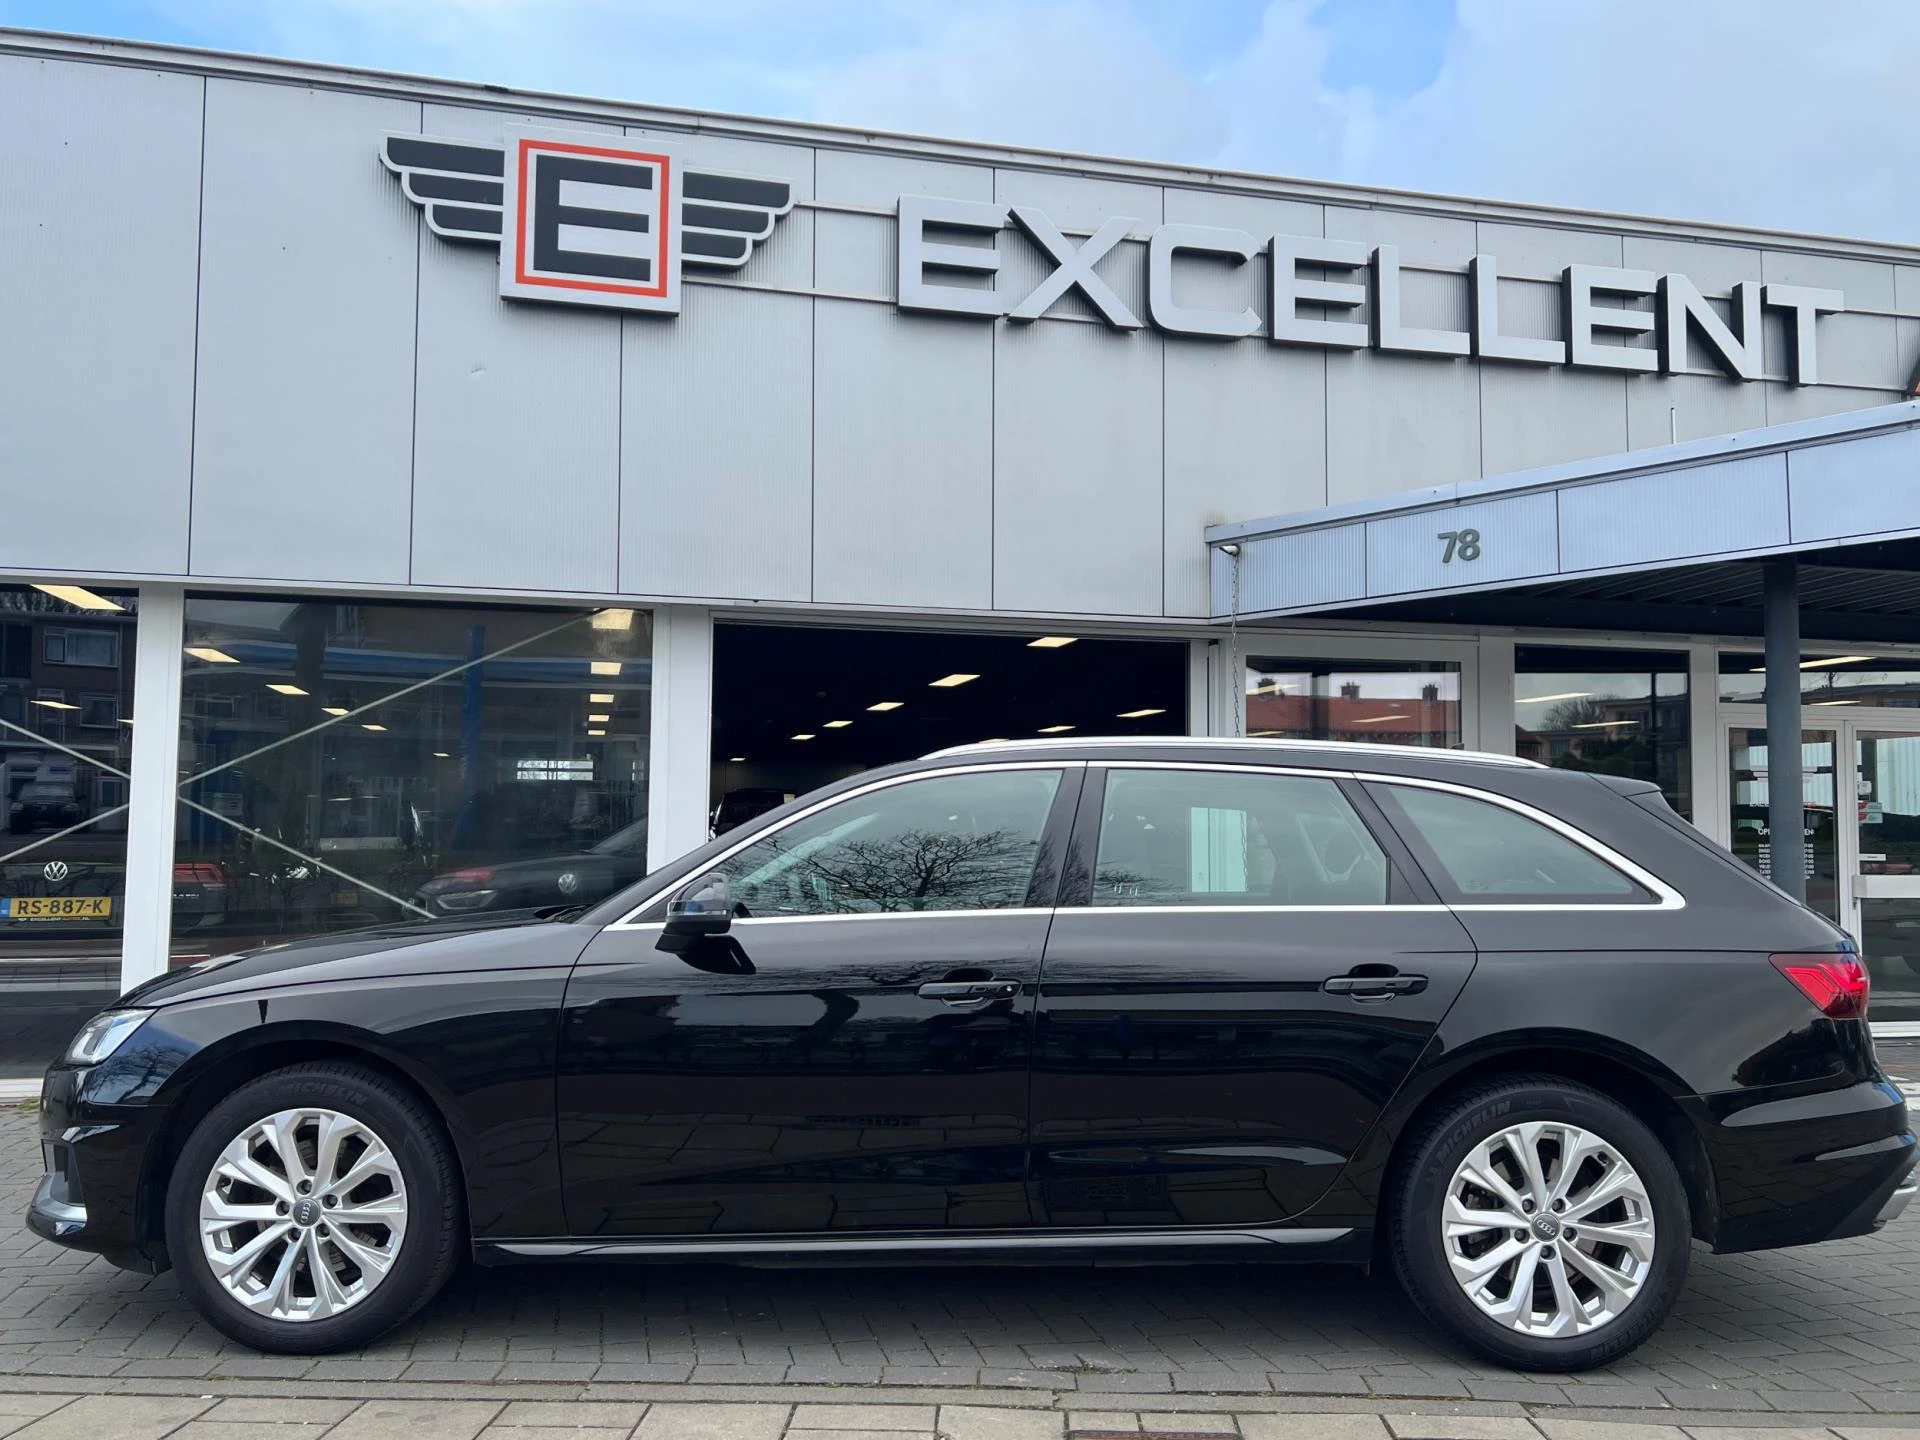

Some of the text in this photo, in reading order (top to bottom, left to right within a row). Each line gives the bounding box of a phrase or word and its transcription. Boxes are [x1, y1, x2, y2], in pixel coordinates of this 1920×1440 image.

[533, 154, 654, 282] E
[897, 194, 1845, 386] EXCELLENT
[1437, 529, 1480, 563] 78
[17, 899, 104, 915] RS-887-K
[1437, 1101, 1512, 1163] MICHELIN
